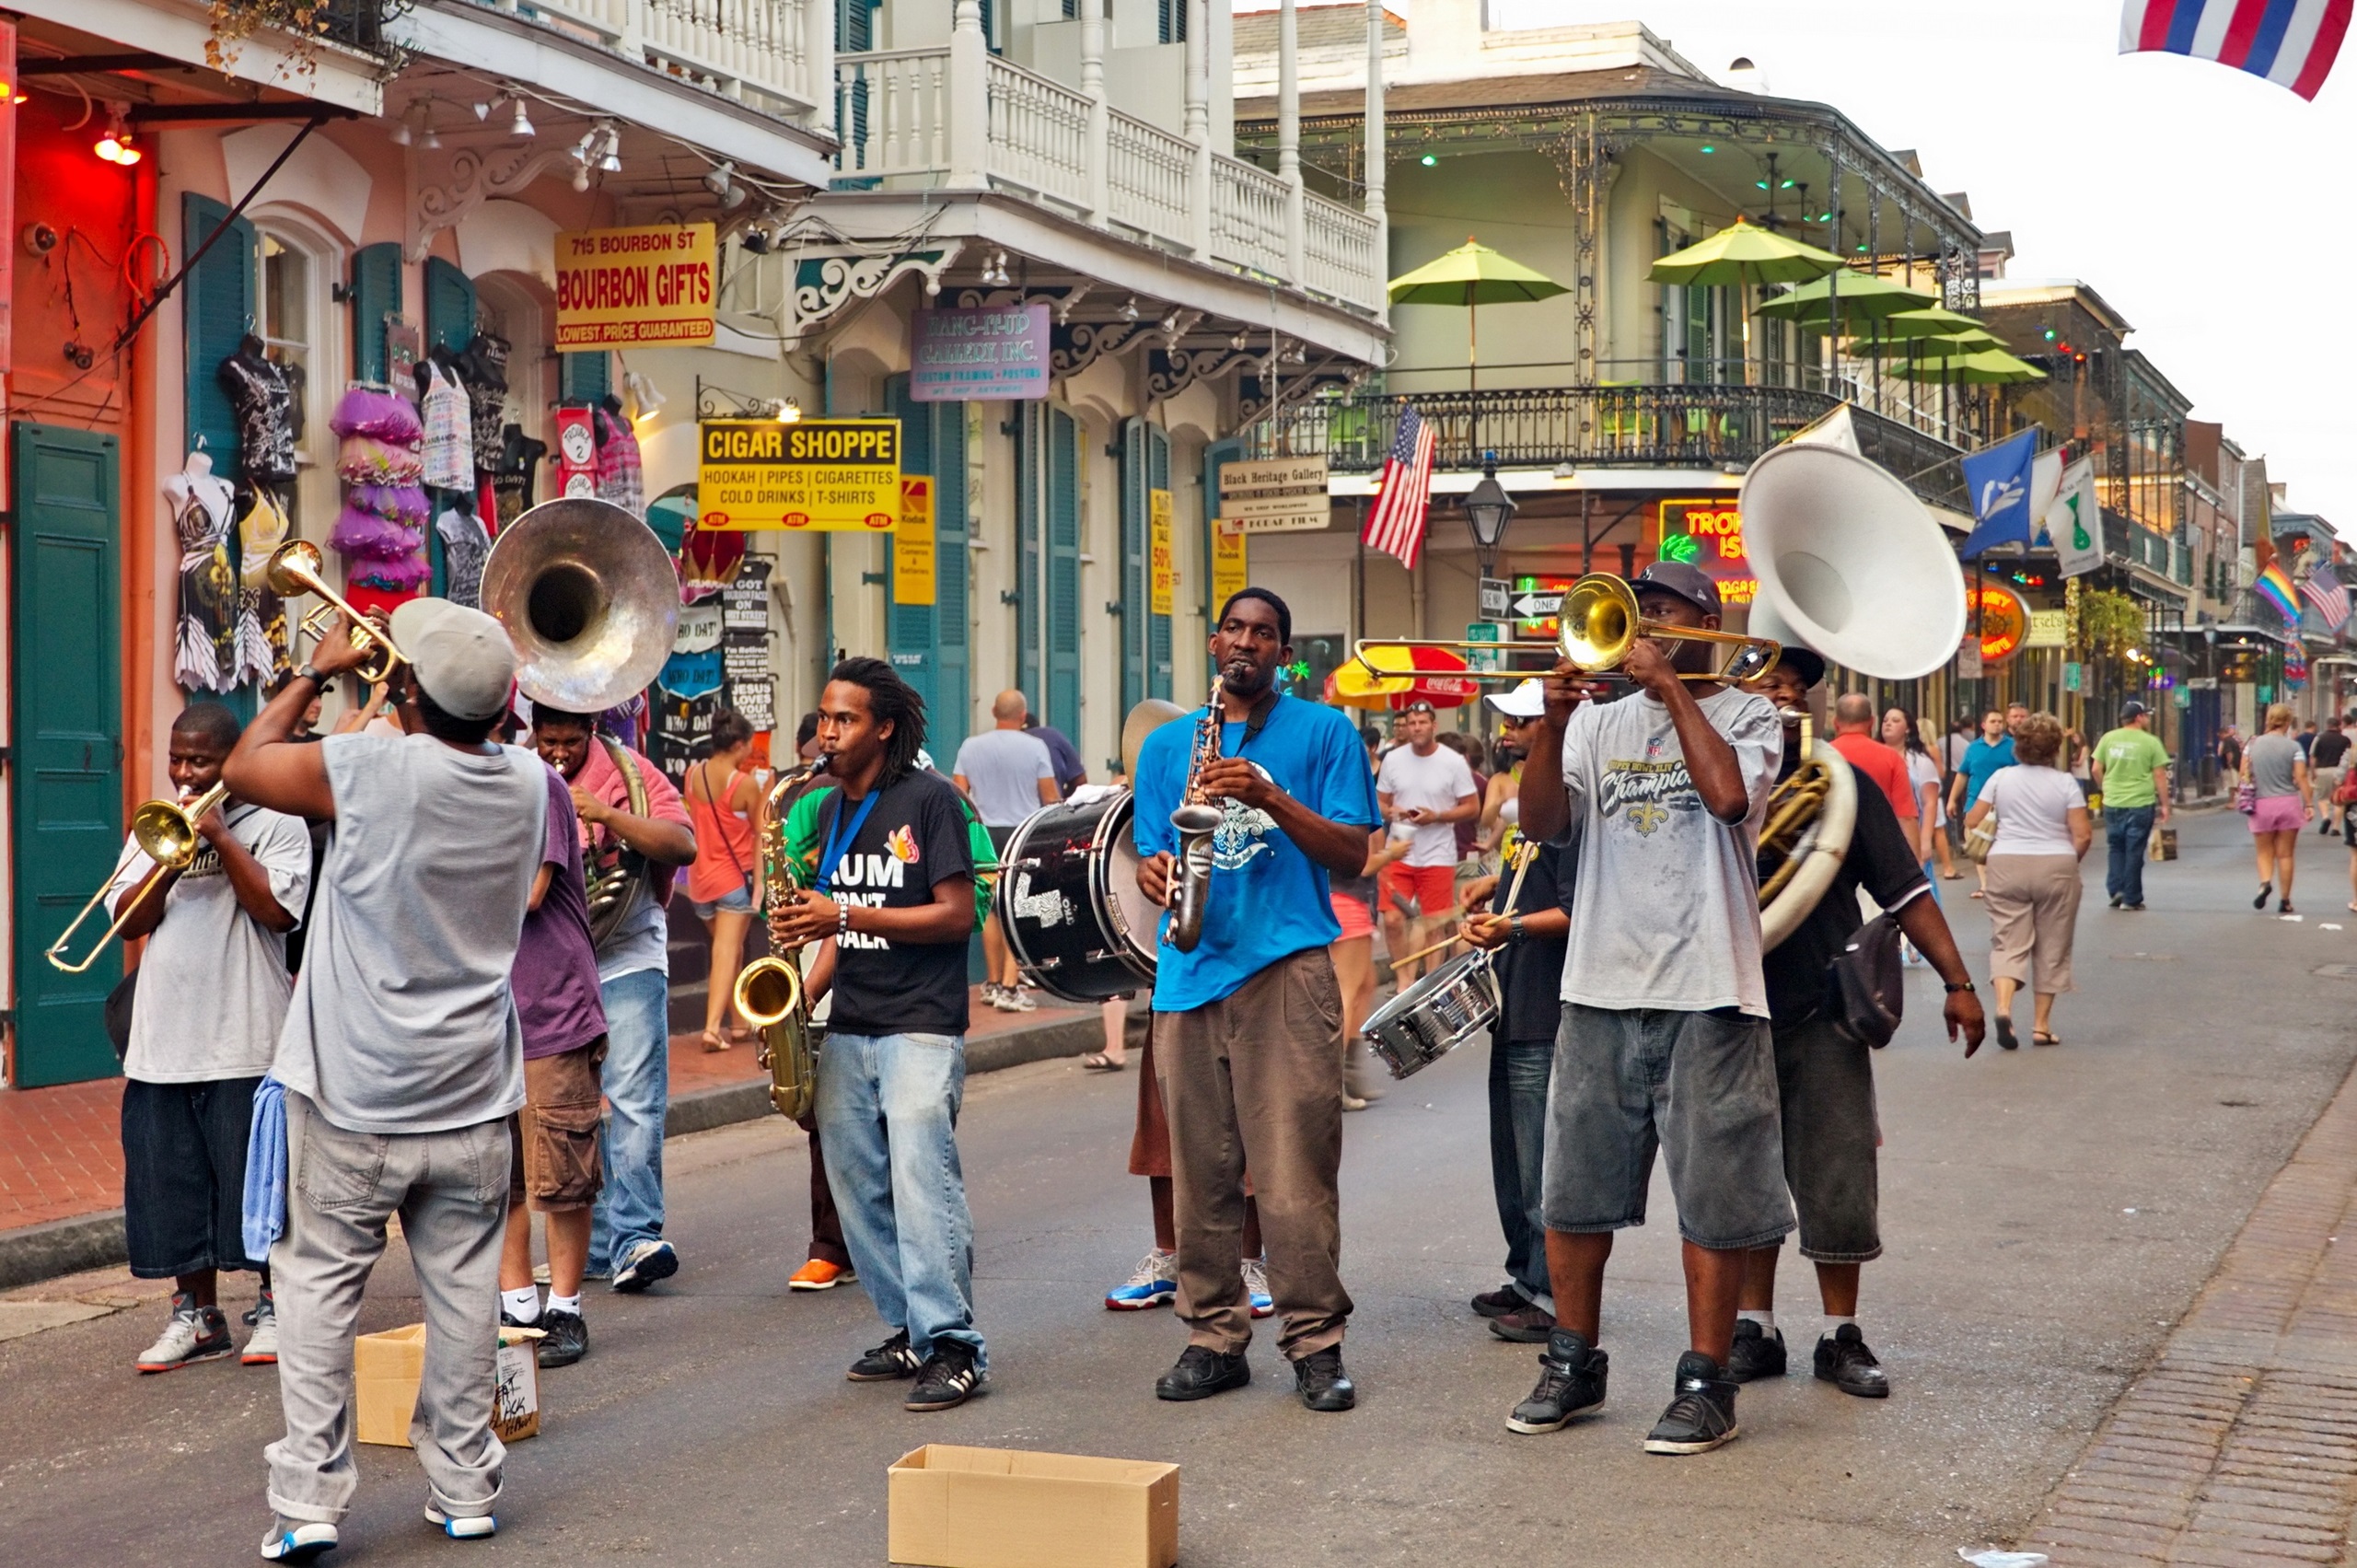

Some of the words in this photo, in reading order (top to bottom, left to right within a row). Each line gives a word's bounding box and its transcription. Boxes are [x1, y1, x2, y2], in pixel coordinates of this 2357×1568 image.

[572, 238, 595, 256] 715
[600, 234, 672, 254] BOURBON
[677, 232, 696, 250] ST
[557, 266, 649, 311] BOURBON
[656, 261, 711, 307] GIFTS
[557, 325, 600, 343] LOWEST
[603, 323, 636, 341] PRICE
[638, 319, 711, 339] GUARANTEED
[926, 314, 1030, 337] HANG-IT-UP
[919, 342, 999, 365] GALLERY,
[1002, 340, 1039, 362] INC.
[563, 426, 591, 444] TROUBLE
[575, 445, 585, 459] 2
[708, 430, 783, 459] CIGAR
[790, 430, 892, 459] SHOPPE
[704, 470, 756, 484] HOOKAH
[767, 470, 804, 484] PIPES
[815, 470, 893, 485] CIGARETTES
[1224, 473, 1248, 485] Black
[1251, 470, 1288, 484] Heritage
[1292, 468, 1323, 482] Gallery
[720, 490, 753, 504] COLD
[757, 491, 805, 505] DRINKS
[817, 491, 876, 505] T-SHIRTS
[708, 515, 726, 524] ATM
[786, 515, 806, 525] ATM
[869, 516, 888, 526] ATM
[900, 514, 926, 524] Kodak
[1686, 511, 1743, 534] TROP
[1720, 535, 1749, 558] ISL
[1153, 547, 1171, 569] 50%
[736, 579, 763, 589] GOT
[1156, 573, 1169, 589] OFF
[736, 600, 752, 610] ON
[1483, 591, 1492, 607] ONE
[1533, 598, 1556, 610] ONE
[2032, 613, 2063, 628] tzel's
[678, 623, 691, 638] HO
[731, 683, 772, 695] JESUS
[732, 693, 772, 706] LOVES
[738, 703, 767, 715] YOU!
[1646, 745, 1663, 756] NFL
[1631, 761, 1654, 772] BOWL
[1655, 762, 1673, 772] XLIV
[1600, 761, 1692, 815] Champio
